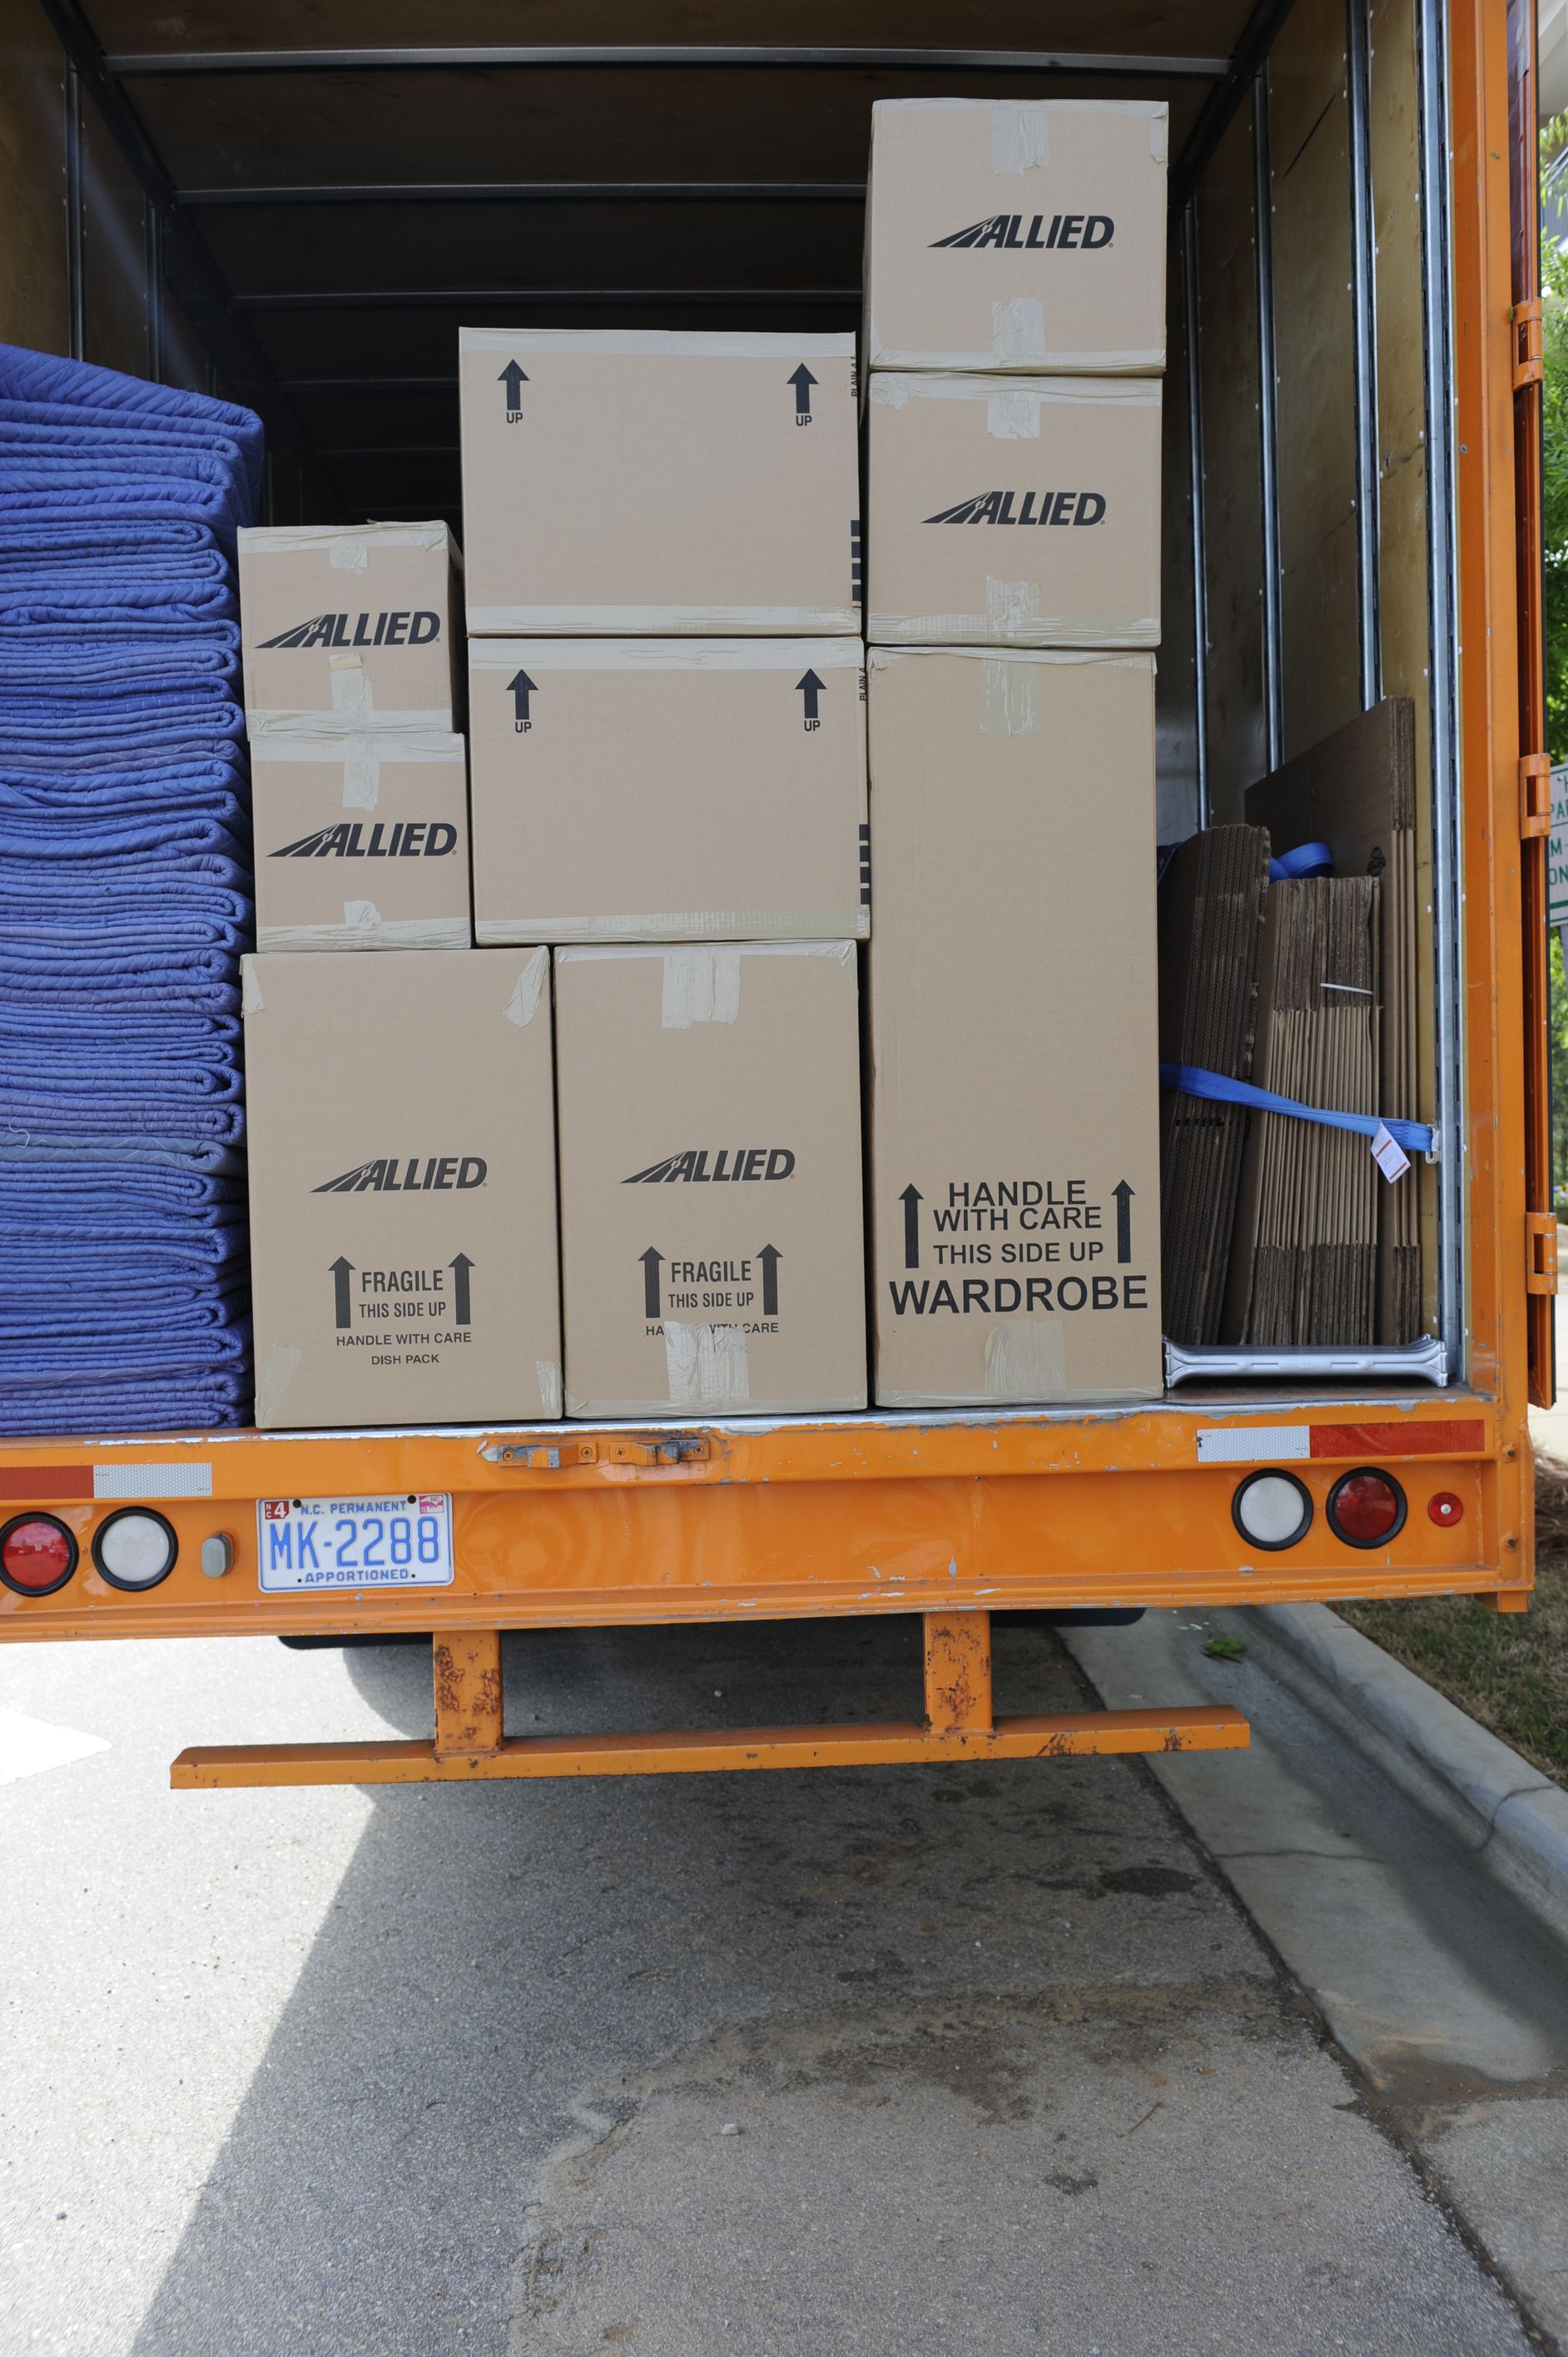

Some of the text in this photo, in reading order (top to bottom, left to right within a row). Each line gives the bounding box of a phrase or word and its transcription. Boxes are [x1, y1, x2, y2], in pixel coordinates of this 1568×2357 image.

[974, 215, 1114, 249] ALLIED
[506, 412, 523, 424] UP
[796, 414, 813, 427] UP
[967, 491, 1106, 525] ALLIED
[301, 612, 440, 648] ALLIED
[515, 721, 532, 733] UP
[804, 720, 821, 732] UP
[315, 823, 457, 856] ALLIED
[354, 1158, 487, 1192] ALLIED
[664, 1149, 795, 1183] ALLIED
[950, 1180, 1087, 1208] HANDLE
[933, 1206, 1103, 1232] WITH CARE
[933, 1242, 1104, 1264] THIS SIDE UP
[361, 1269, 444, 1293] FRAGILE
[672, 1260, 752, 1283] FRAGILE
[668, 1292, 754, 1308] THIS SIDE UP
[889, 1275, 1149, 1315] WARDROBE
[359, 1301, 446, 1318] THIS SIDE UP
[742, 1322, 779, 1334] CARE
[336, 1332, 472, 1347] HANDLE WITH CARE
[371, 1353, 440, 1366] DISH PACK
[274, 1502, 286, 1517] 4
[300, 1501, 406, 1516] N.C. PERMANENT
[270, 1516, 439, 1571] MK-2288
[305, 1569, 408, 1583] APPORTIONED
